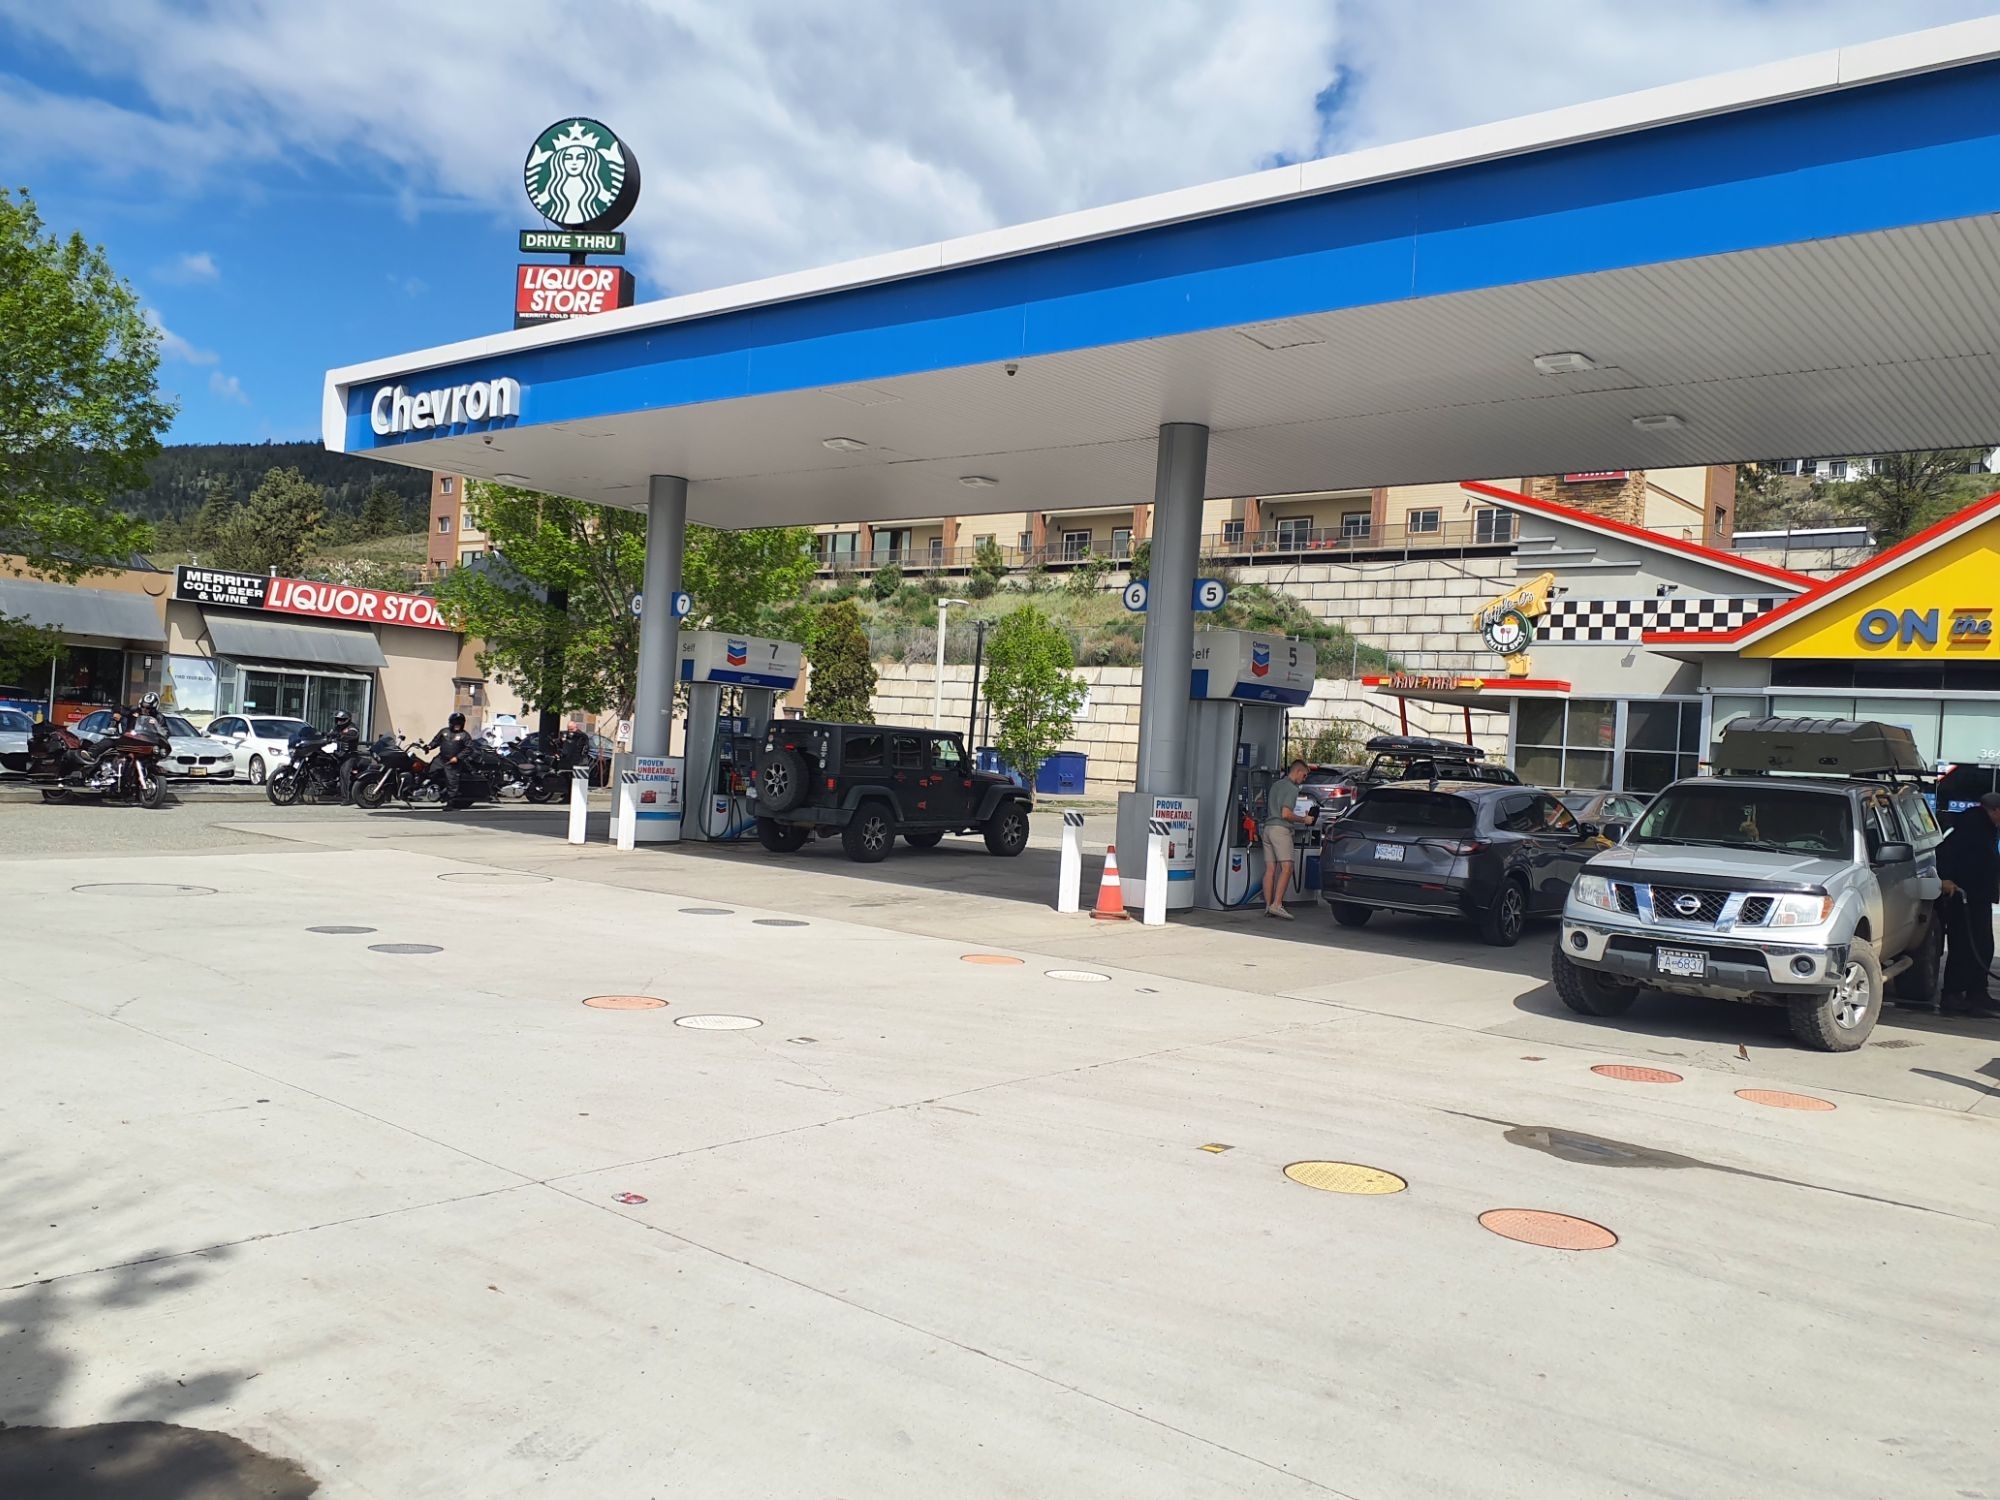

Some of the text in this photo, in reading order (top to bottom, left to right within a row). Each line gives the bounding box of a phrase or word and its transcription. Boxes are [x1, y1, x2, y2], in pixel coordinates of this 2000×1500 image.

[525, 234, 616, 249] DRIVE THRU
[523, 268, 614, 291] LIQUOR
[530, 290, 604, 312] STORE
[370, 377, 521, 436] Chevron
[186, 570, 262, 589] MERRITT
[183, 581, 264, 598] COLD BEER
[1131, 589, 1141, 604] 6
[1206, 587, 1217, 602] 5
[198, 591, 249, 605] & WINE
[268, 581, 378, 618] LIQUOR
[634, 599, 641, 610] 8
[680, 599, 687, 611] 7
[1859, 609, 1992, 644] ON the
[682, 642, 696, 653] Self
[1485, 631, 1526, 652] WHITE SPOT
[769, 643, 779, 660] 7
[1288, 646, 1298, 668] 5
[637, 766, 677, 775] UNBEATABLE
[638, 759, 664, 767] PROVEN
[1156, 800, 1183, 810] PROVEN
[1155, 810, 1193, 820] UNBEATABLE
